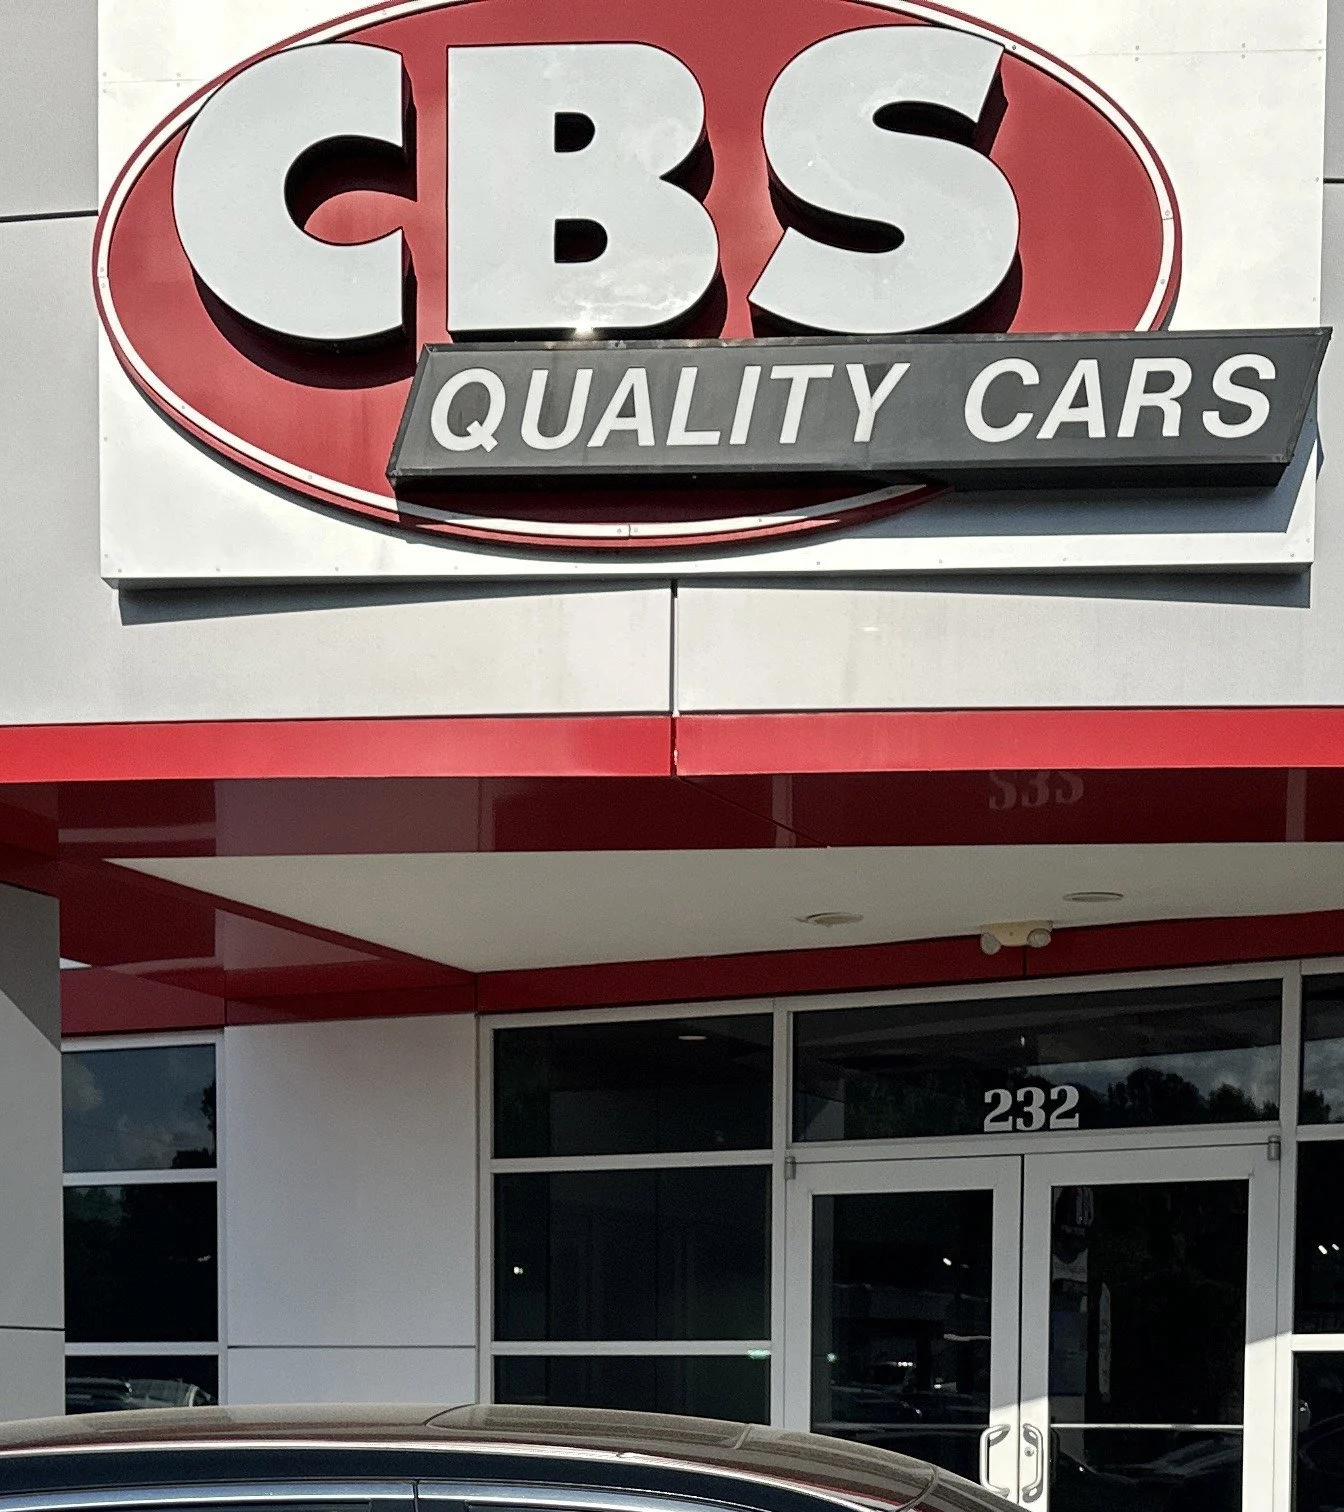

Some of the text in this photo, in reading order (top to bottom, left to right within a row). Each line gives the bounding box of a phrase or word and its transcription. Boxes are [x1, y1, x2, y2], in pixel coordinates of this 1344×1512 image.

[172, 26, 1021, 342] CBS
[429, 352, 1278, 453] QUALITY CARS
[983, 1085, 1080, 1133] 232
